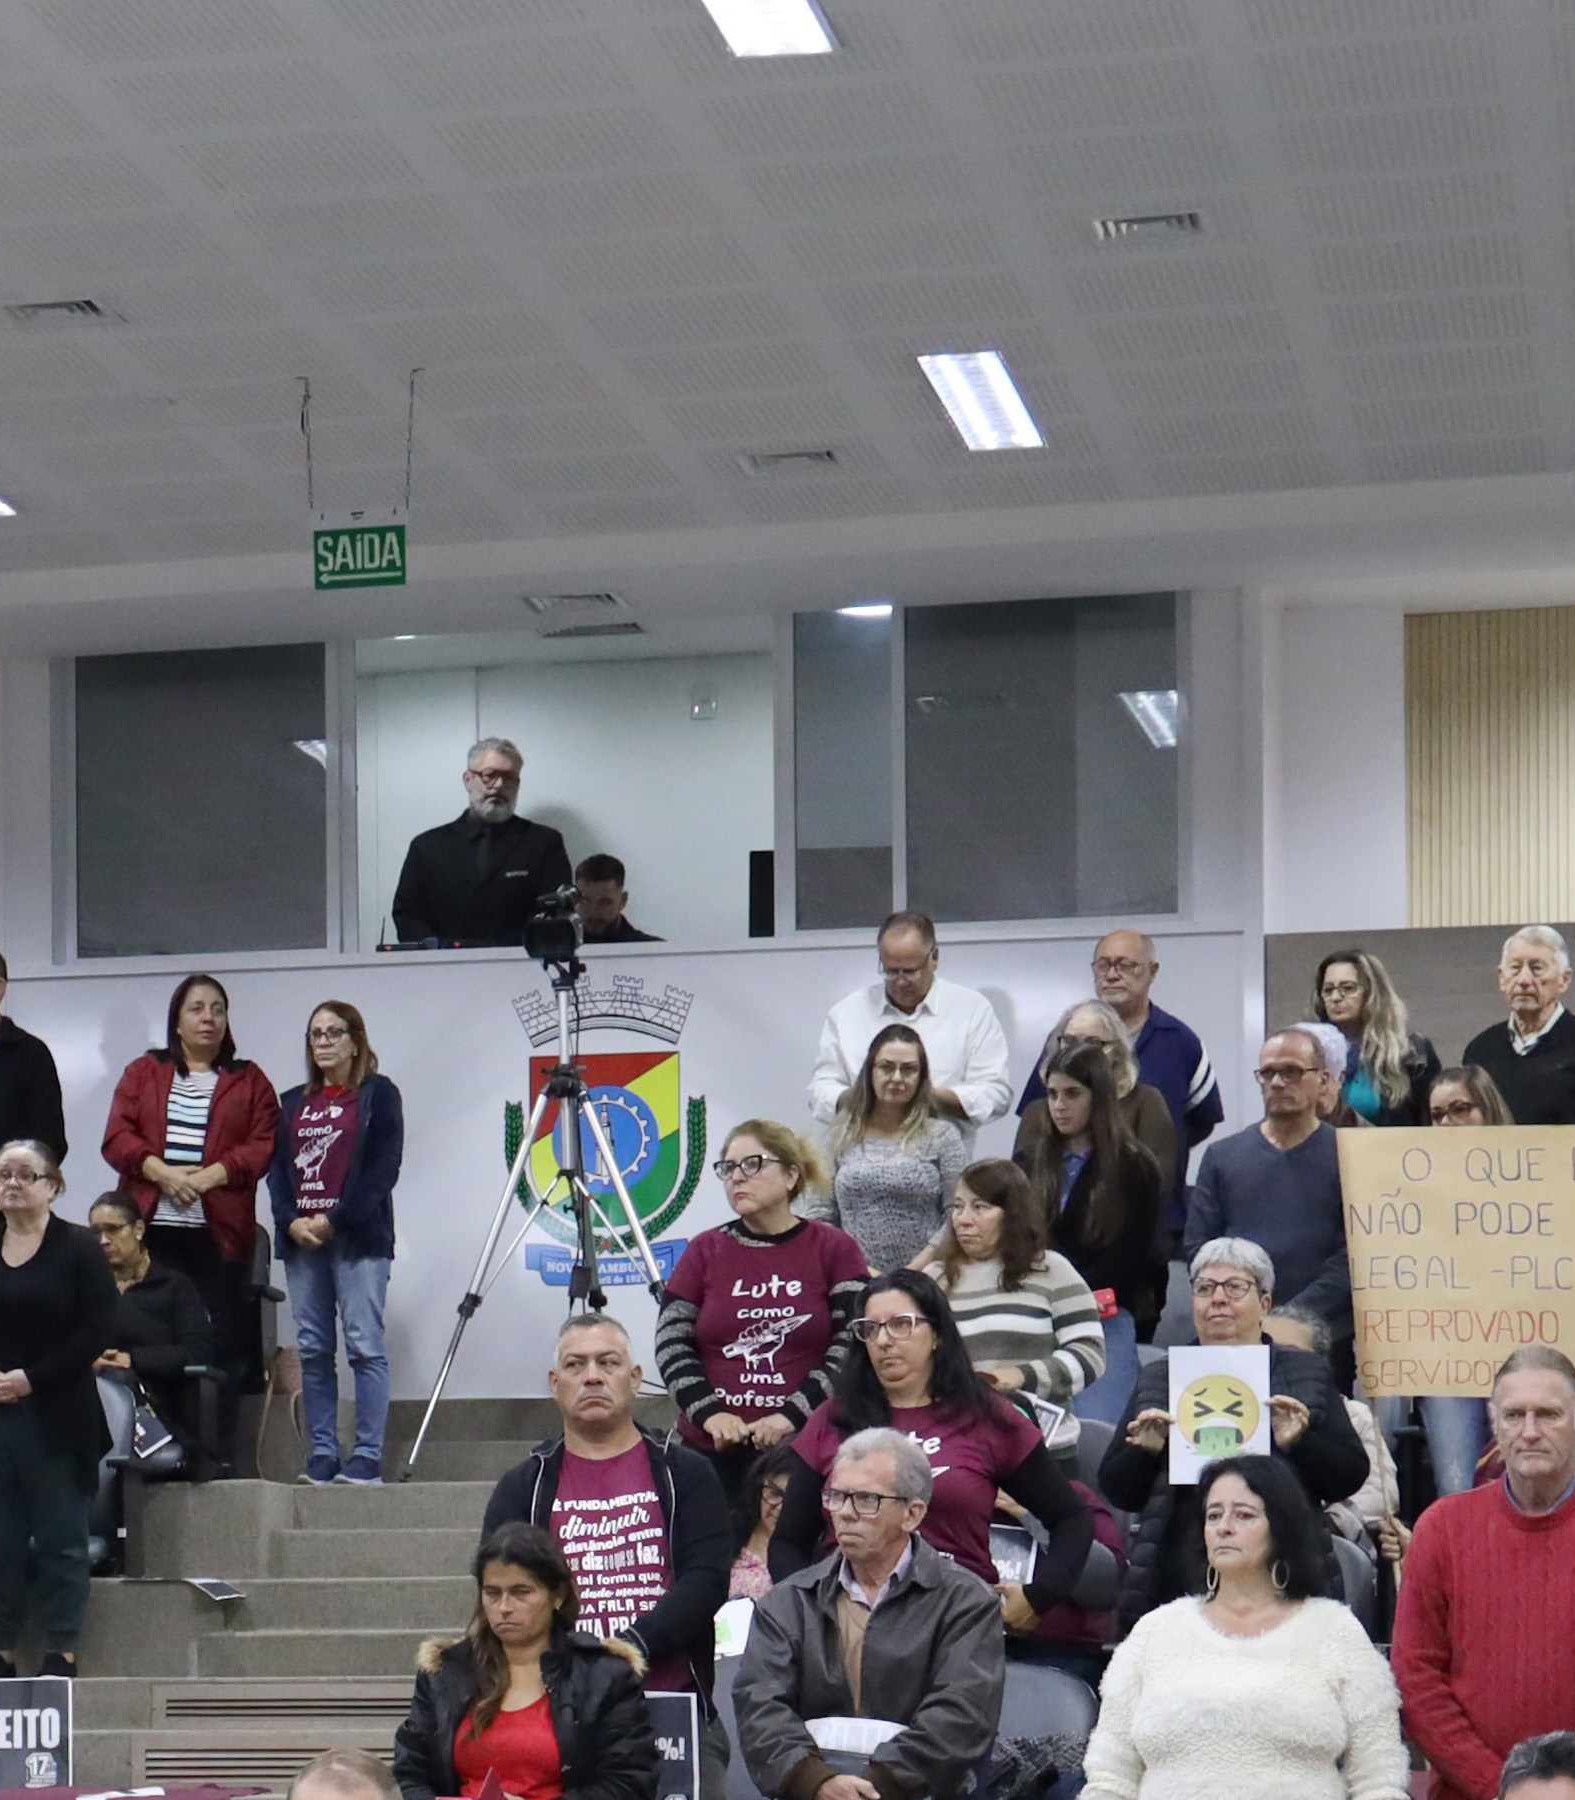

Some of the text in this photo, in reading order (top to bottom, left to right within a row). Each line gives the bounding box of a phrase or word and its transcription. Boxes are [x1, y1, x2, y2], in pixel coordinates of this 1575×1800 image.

[298, 1123, 333, 1137] como
[1402, 1146, 1432, 1183] O
[1464, 1146, 1547, 1188] QUE
[1348, 1187, 1422, 1237] NÃO
[1454, 1200, 1555, 1238] PODE
[731, 1273, 803, 1298] Lute
[1350, 1254, 1471, 1293] LEGAL
[736, 1305, 796, 1319] como
[1361, 1308, 1560, 1345] REPROVADO
[739, 1372, 786, 1385] uma
[551, 1490, 659, 1512] É FUNDAMENTAL
[559, 1506, 650, 1539] diminuir
[563, 1527, 663, 1554] distância entre
[581, 1552, 604, 1571] diz
[576, 1574, 593, 1585] tal
[596, 1572, 636, 1585] forma
